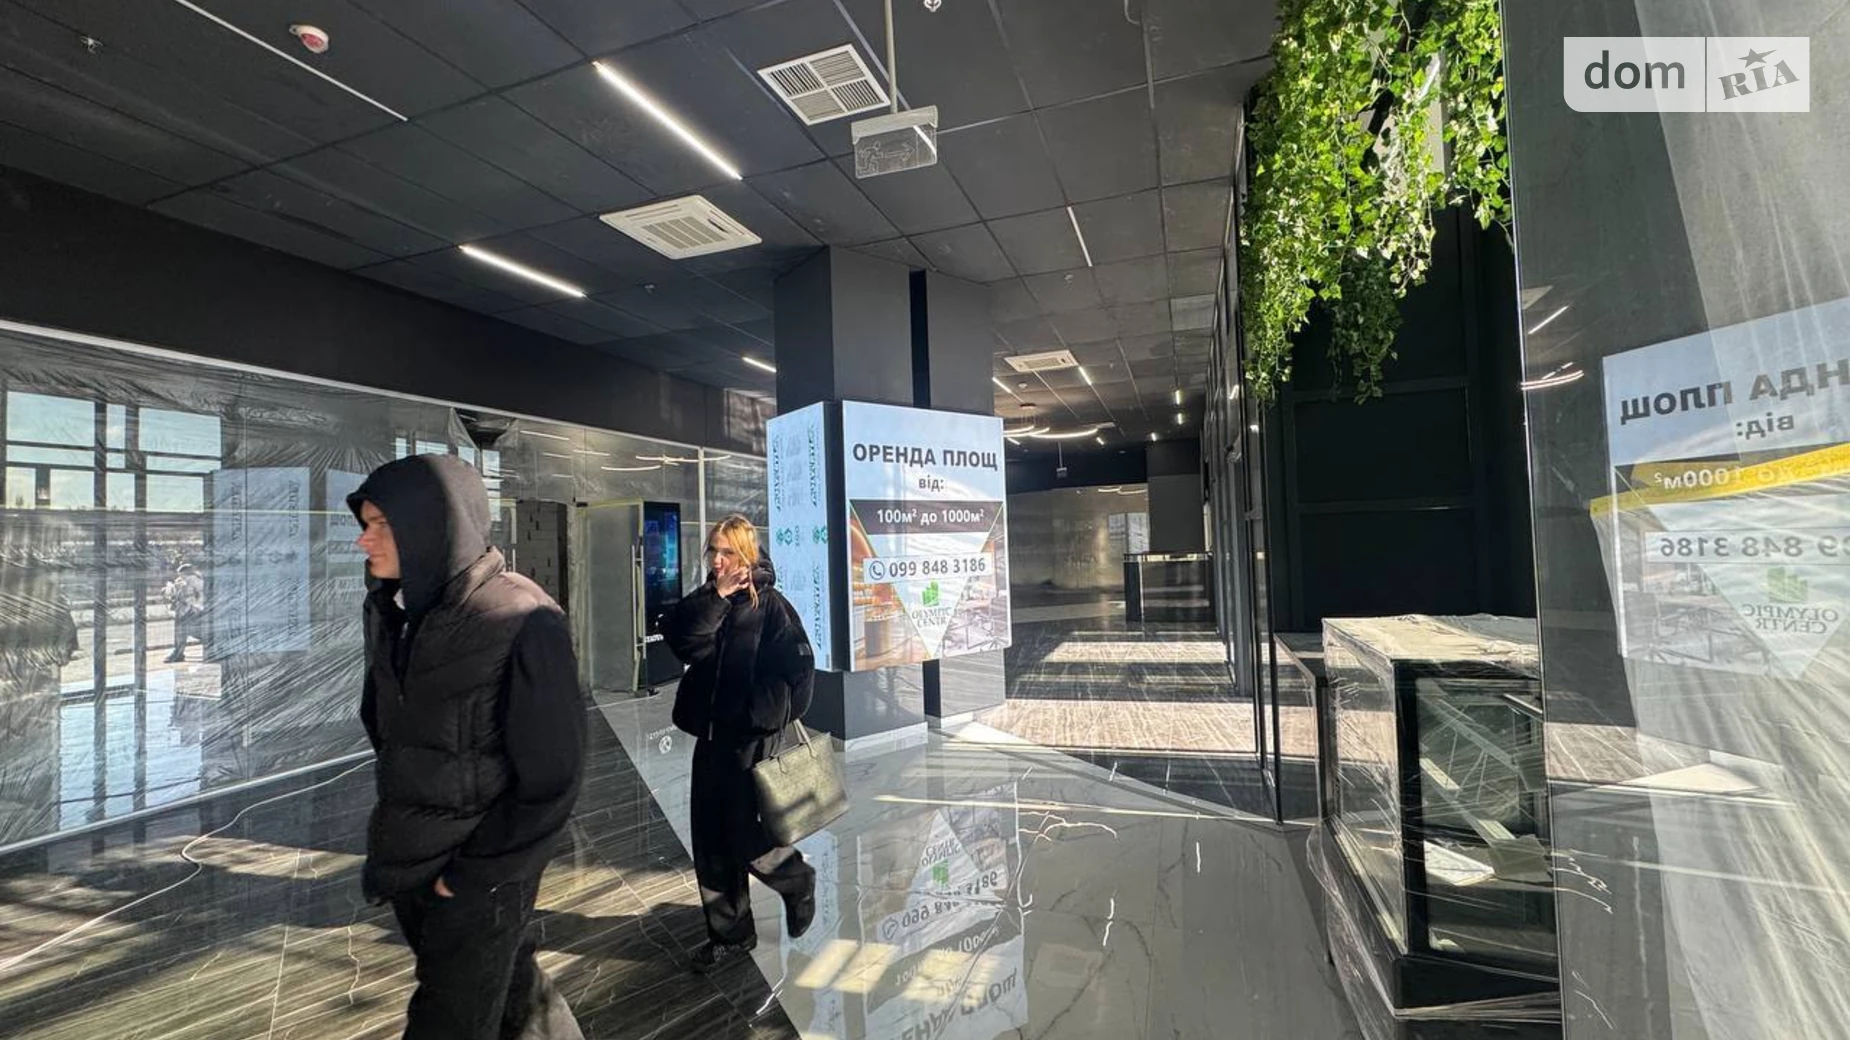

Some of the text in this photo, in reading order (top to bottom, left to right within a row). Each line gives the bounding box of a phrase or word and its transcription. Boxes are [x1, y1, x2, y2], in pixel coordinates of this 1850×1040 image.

[853, 443, 998, 471] ОРЕНДА ПЛОЩ
[918, 474, 945, 492] від:
[920, 511, 938, 525] до
[889, 557, 986, 578] 099 848 3186
[911, 607, 952, 620] OLYMPIC
